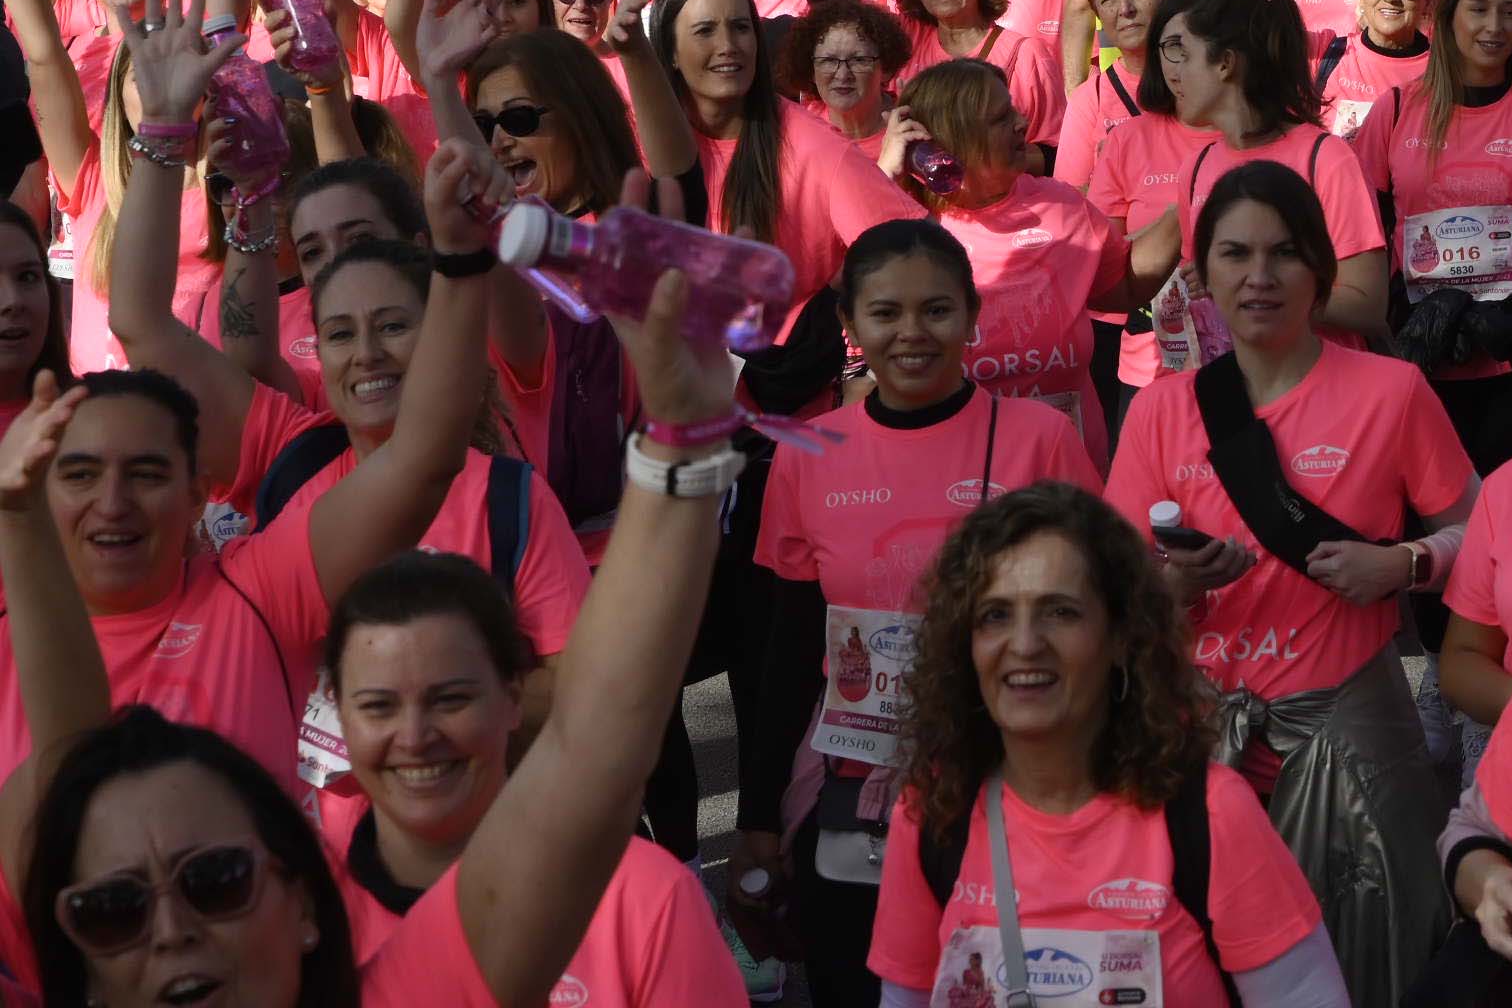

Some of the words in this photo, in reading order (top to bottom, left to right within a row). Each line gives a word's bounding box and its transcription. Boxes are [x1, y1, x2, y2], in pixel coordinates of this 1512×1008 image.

[1439, 224, 1480, 236] ASTURIANA
[1449, 265, 1475, 276] 5830
[825, 486, 892, 510] OYSHO
[839, 715, 877, 729] CARRERA
[304, 729, 339, 751] MUJER
[829, 733, 877, 752] OYSHO
[1096, 893, 1168, 910] ASTURIANA
[1099, 960, 1144, 973] SUMA
